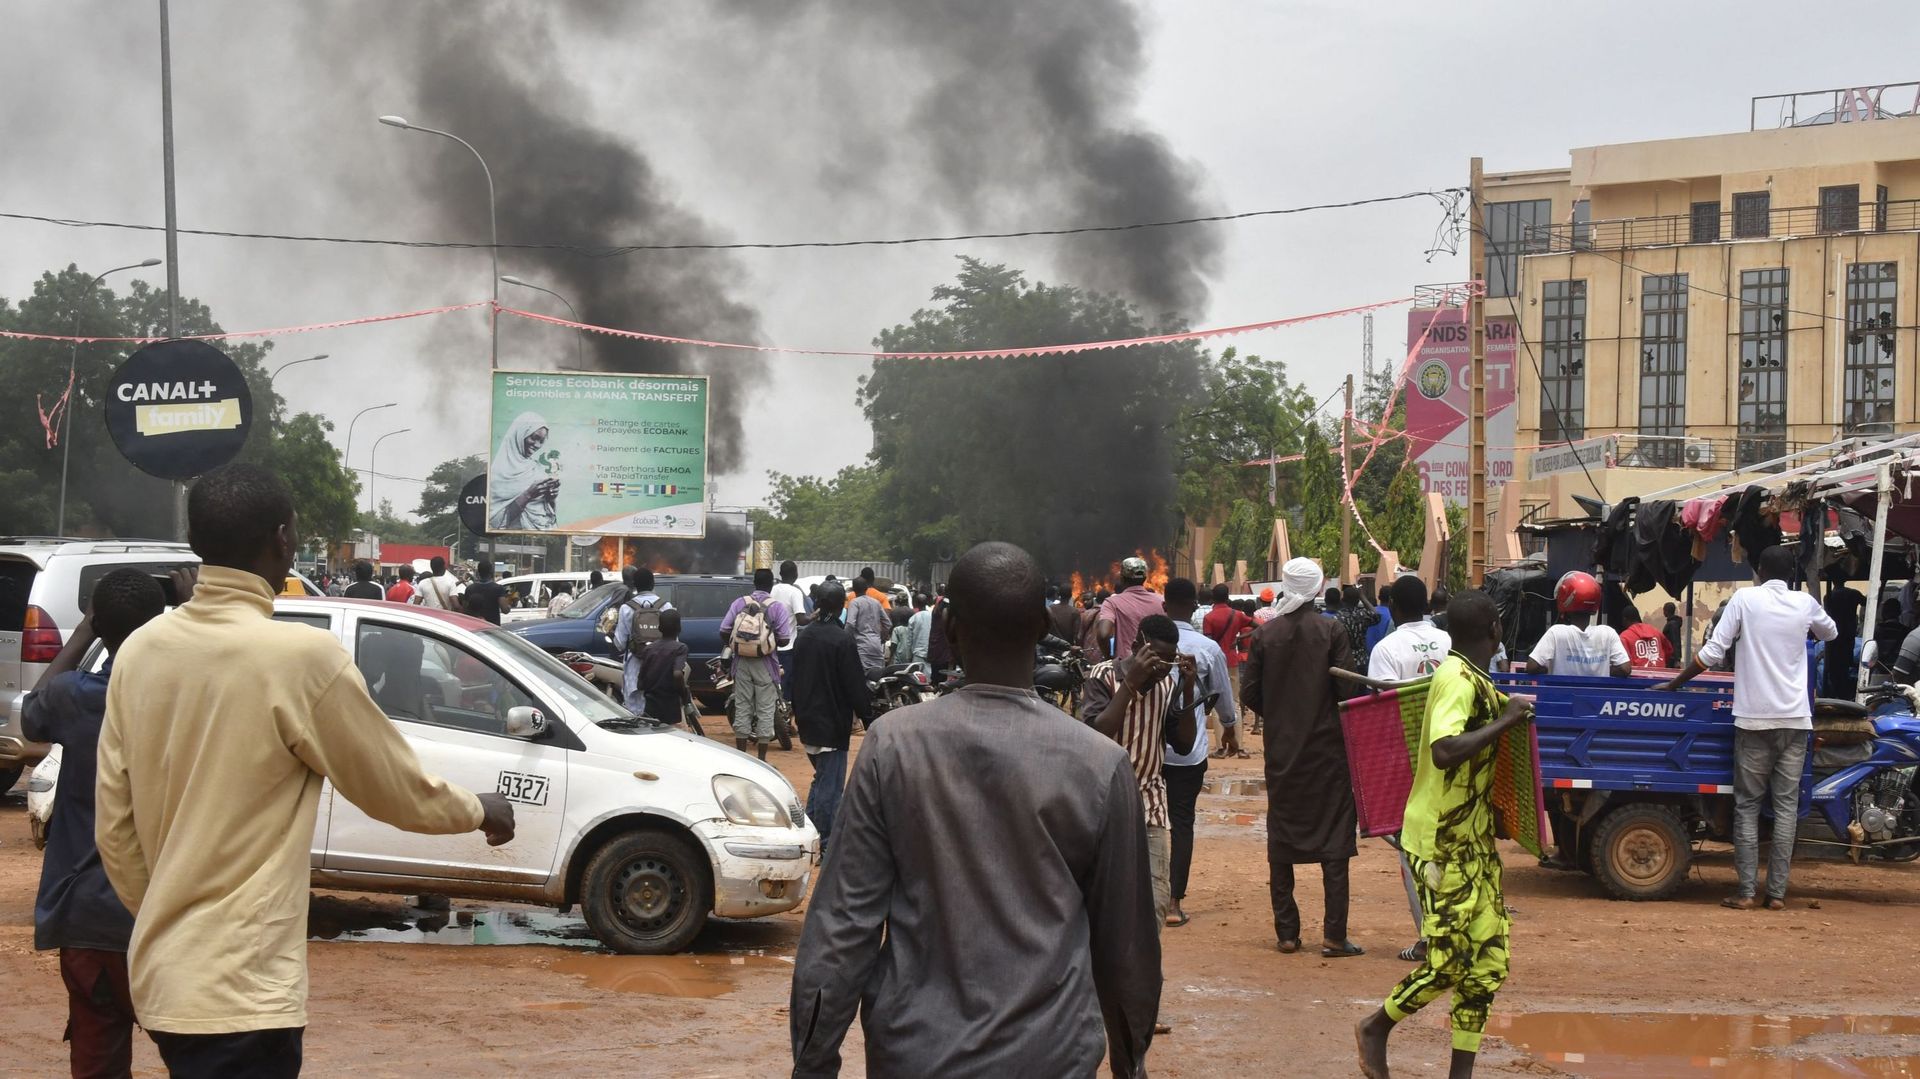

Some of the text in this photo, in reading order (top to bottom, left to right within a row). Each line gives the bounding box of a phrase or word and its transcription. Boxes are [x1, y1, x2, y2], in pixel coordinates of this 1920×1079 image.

[506, 376, 699, 391] Services Ecobank désormais
[117, 380, 217, 402] CANAL+
[505, 388, 571, 399] disponibles
[583, 391, 628, 400] AMANA
[631, 392, 698, 402] TRANSFERT
[148, 403, 226, 428] family
[598, 419, 639, 428] Recharge
[597, 445, 638, 453] Paiement
[636, 465, 655, 473] hors
[1412, 641, 1439, 652] NDC
[1599, 701, 1686, 718] APSONIC
[501, 776, 545, 801] 9327
